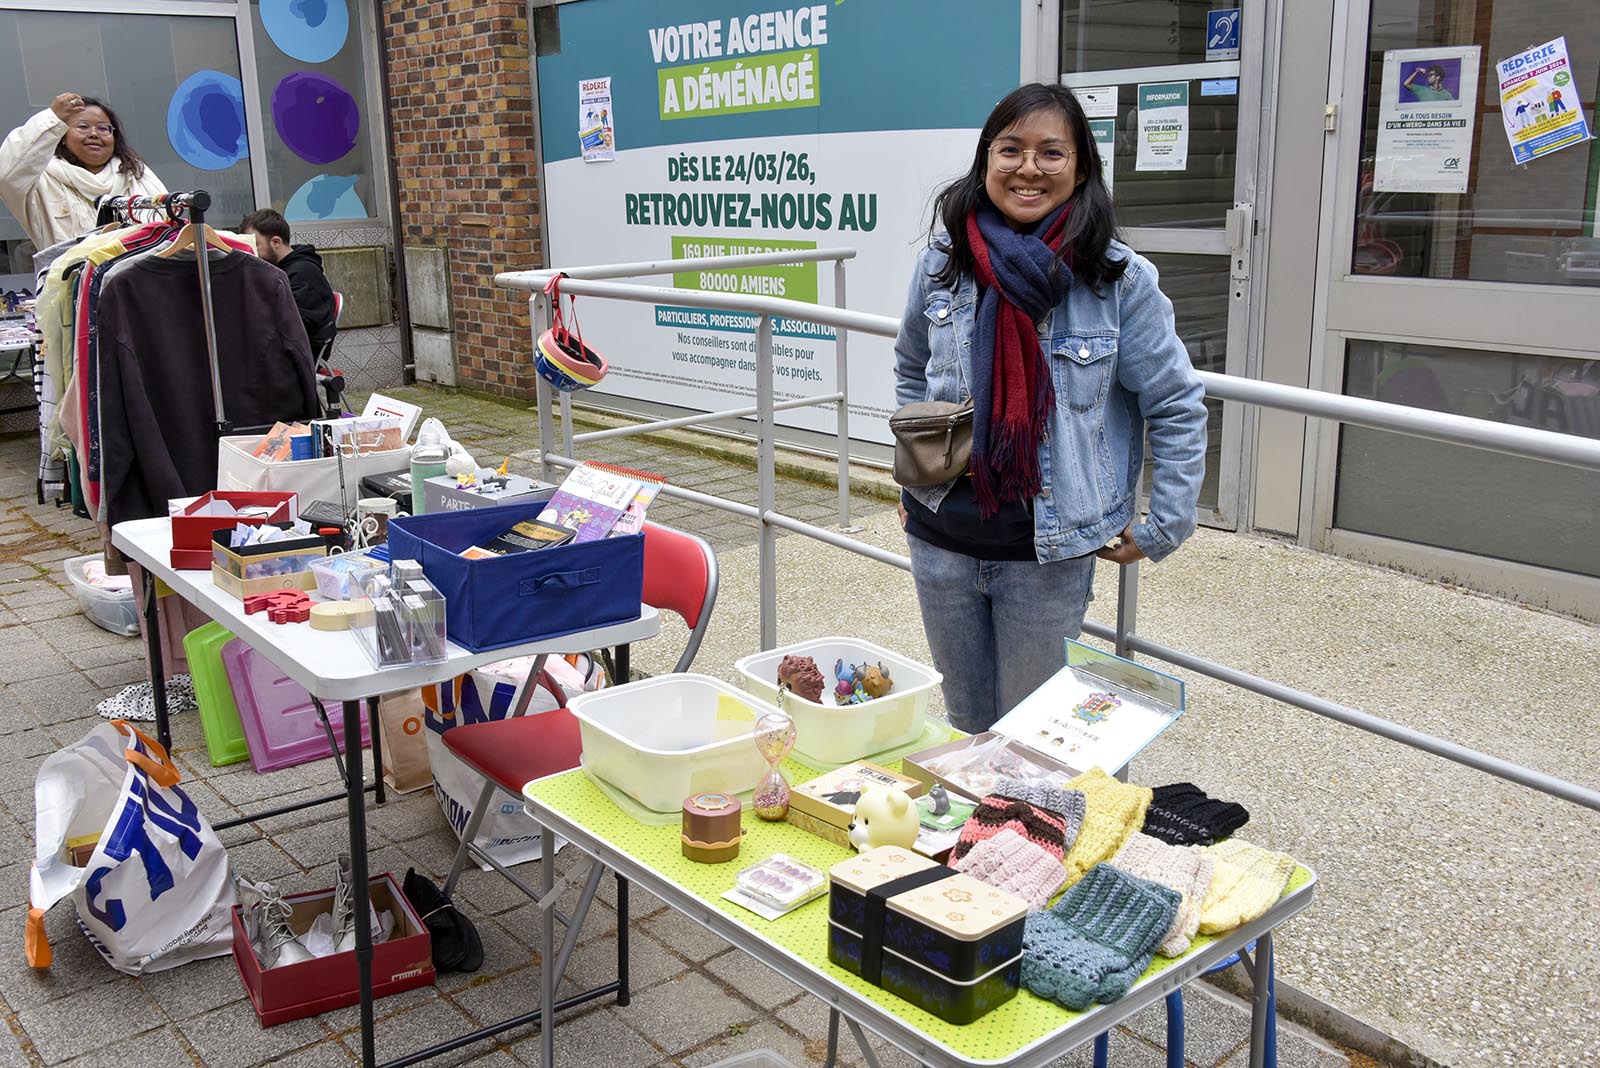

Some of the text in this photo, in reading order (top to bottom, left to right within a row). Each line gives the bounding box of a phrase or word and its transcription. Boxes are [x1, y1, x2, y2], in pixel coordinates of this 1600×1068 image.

[649, 5, 828, 63] VOTRE AGENCE
[1231, 38, 1236, 46] T
[1502, 44, 1556, 74] RÉDERIE
[663, 53, 815, 114] A DÉMÉNAGÉ
[1146, 92, 1181, 101] INFORMATION
[1161, 124, 1182, 132] AGENCE
[668, 151, 816, 186] DÈS LE 24/03/26,
[625, 192, 878, 232] RETROUVEZ-NOUS AU
[682, 243, 701, 259] 169
[699, 271, 786, 296] 80000 AMIENS
[657, 310, 710, 328] PARTICULIERS,
[677, 332, 691, 344] Nos
[692, 335, 729, 350] conseillers
[731, 340, 747, 352] sont
[795, 349, 814, 361] pour
[672, 351, 688, 362] vous
[689, 353, 737, 369] accompagner
[738, 358, 756, 372] dans
[776, 365, 790, 377] vos
[791, 364, 823, 381] projets.
[160, 934, 183, 952] Global
[178, 924, 208, 946] Standard
